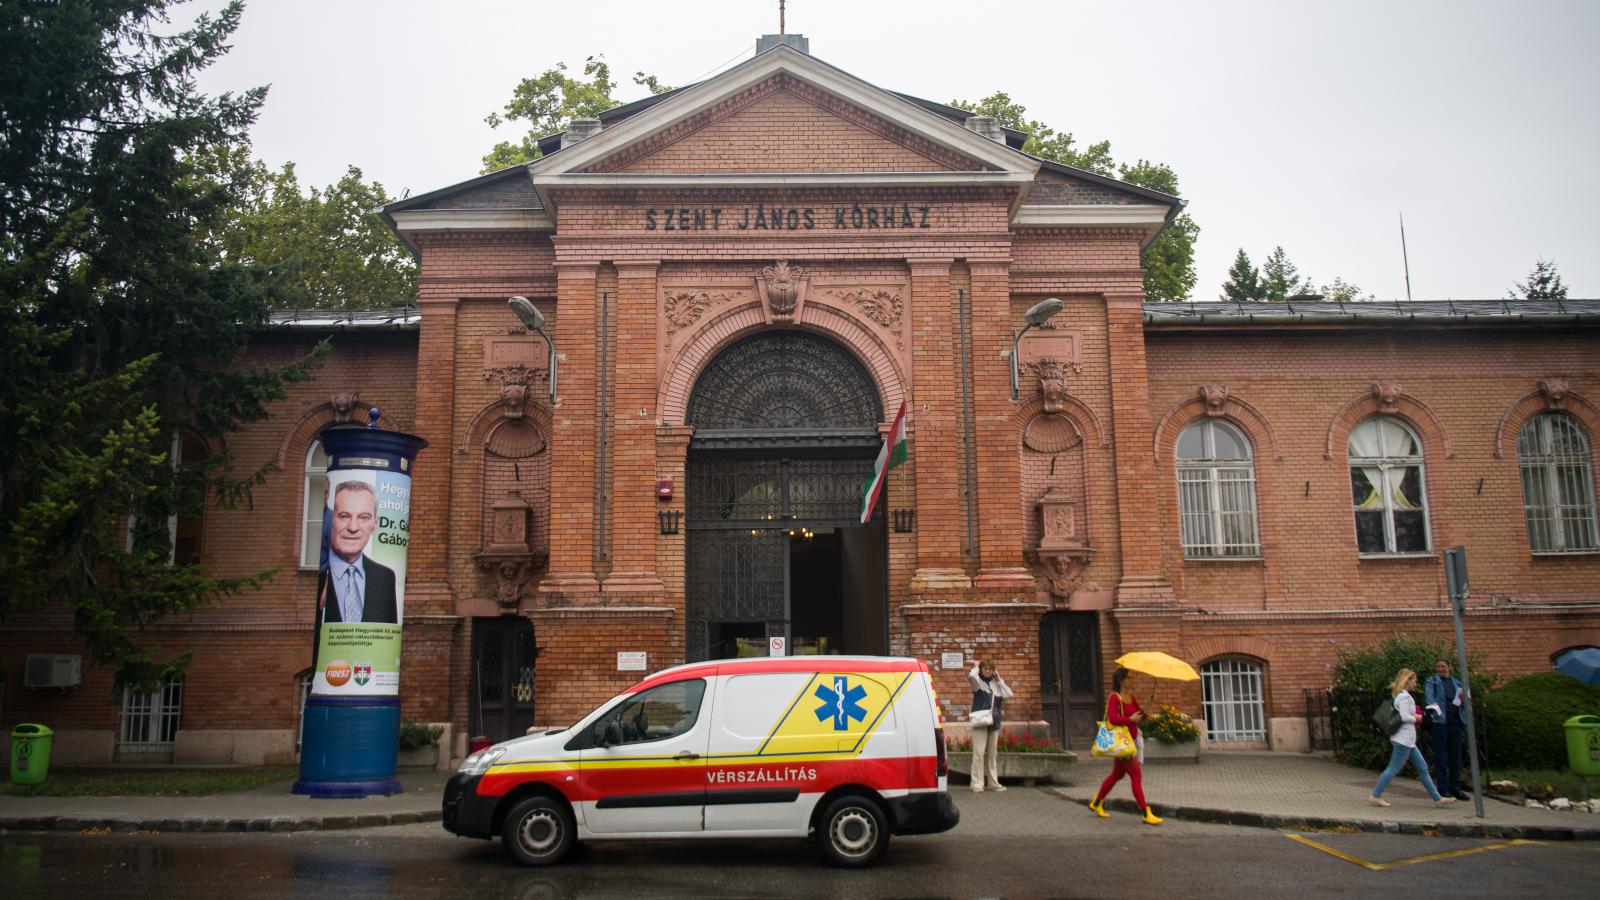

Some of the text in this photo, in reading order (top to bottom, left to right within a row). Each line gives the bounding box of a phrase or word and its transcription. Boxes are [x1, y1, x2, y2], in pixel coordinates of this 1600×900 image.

[646, 202, 931, 230] SZENT JÁNOS KÓRHÁZ
[380, 498, 403, 512] ahol
[379, 516, 397, 529] Dr.
[326, 669, 350, 678] FIDESZ
[707, 767, 817, 783] VÉRSZÁLLÍTÁS
